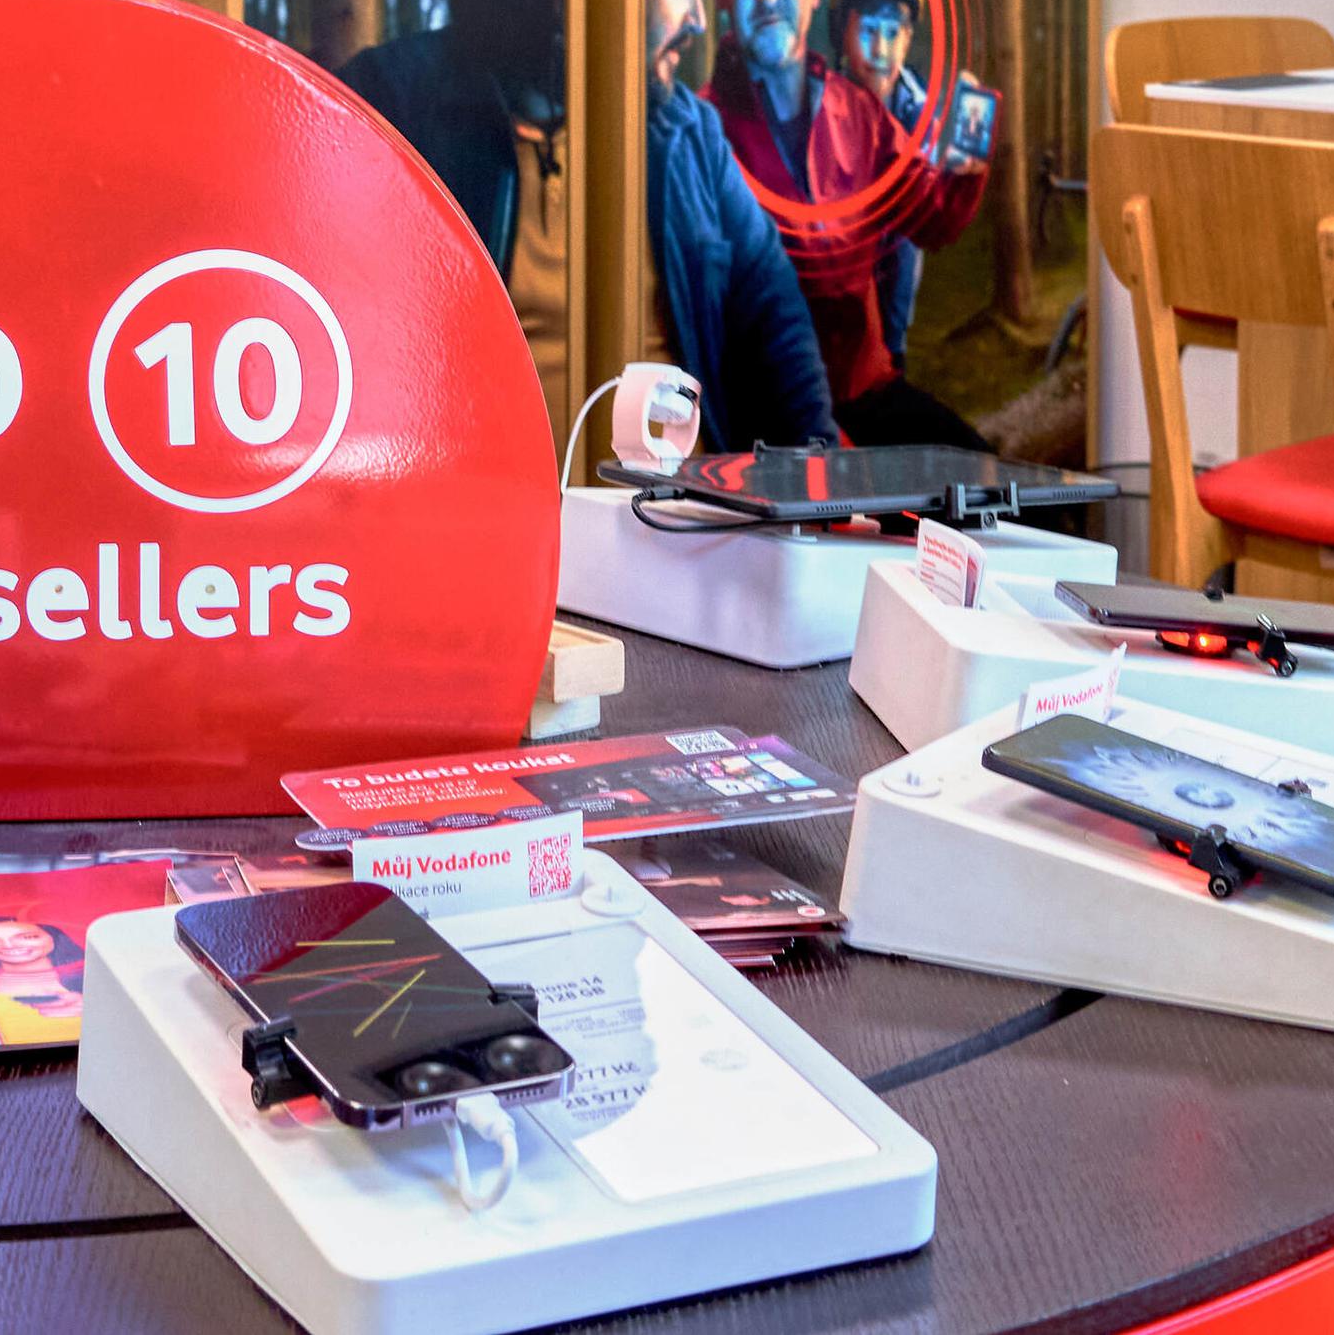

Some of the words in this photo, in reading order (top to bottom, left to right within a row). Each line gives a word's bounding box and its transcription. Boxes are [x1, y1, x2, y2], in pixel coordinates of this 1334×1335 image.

[133, 316, 303, 446] 10
[1035, 695, 1060, 714] Můj
[322, 775, 361, 789] To
[366, 764, 470, 786] budete
[473, 752, 577, 774] koukat
[372, 855, 412, 880] Můj
[416, 849, 511, 874] Vodafone
[432, 880, 462, 896] roku
[591, 1087, 628, 1104] 977
